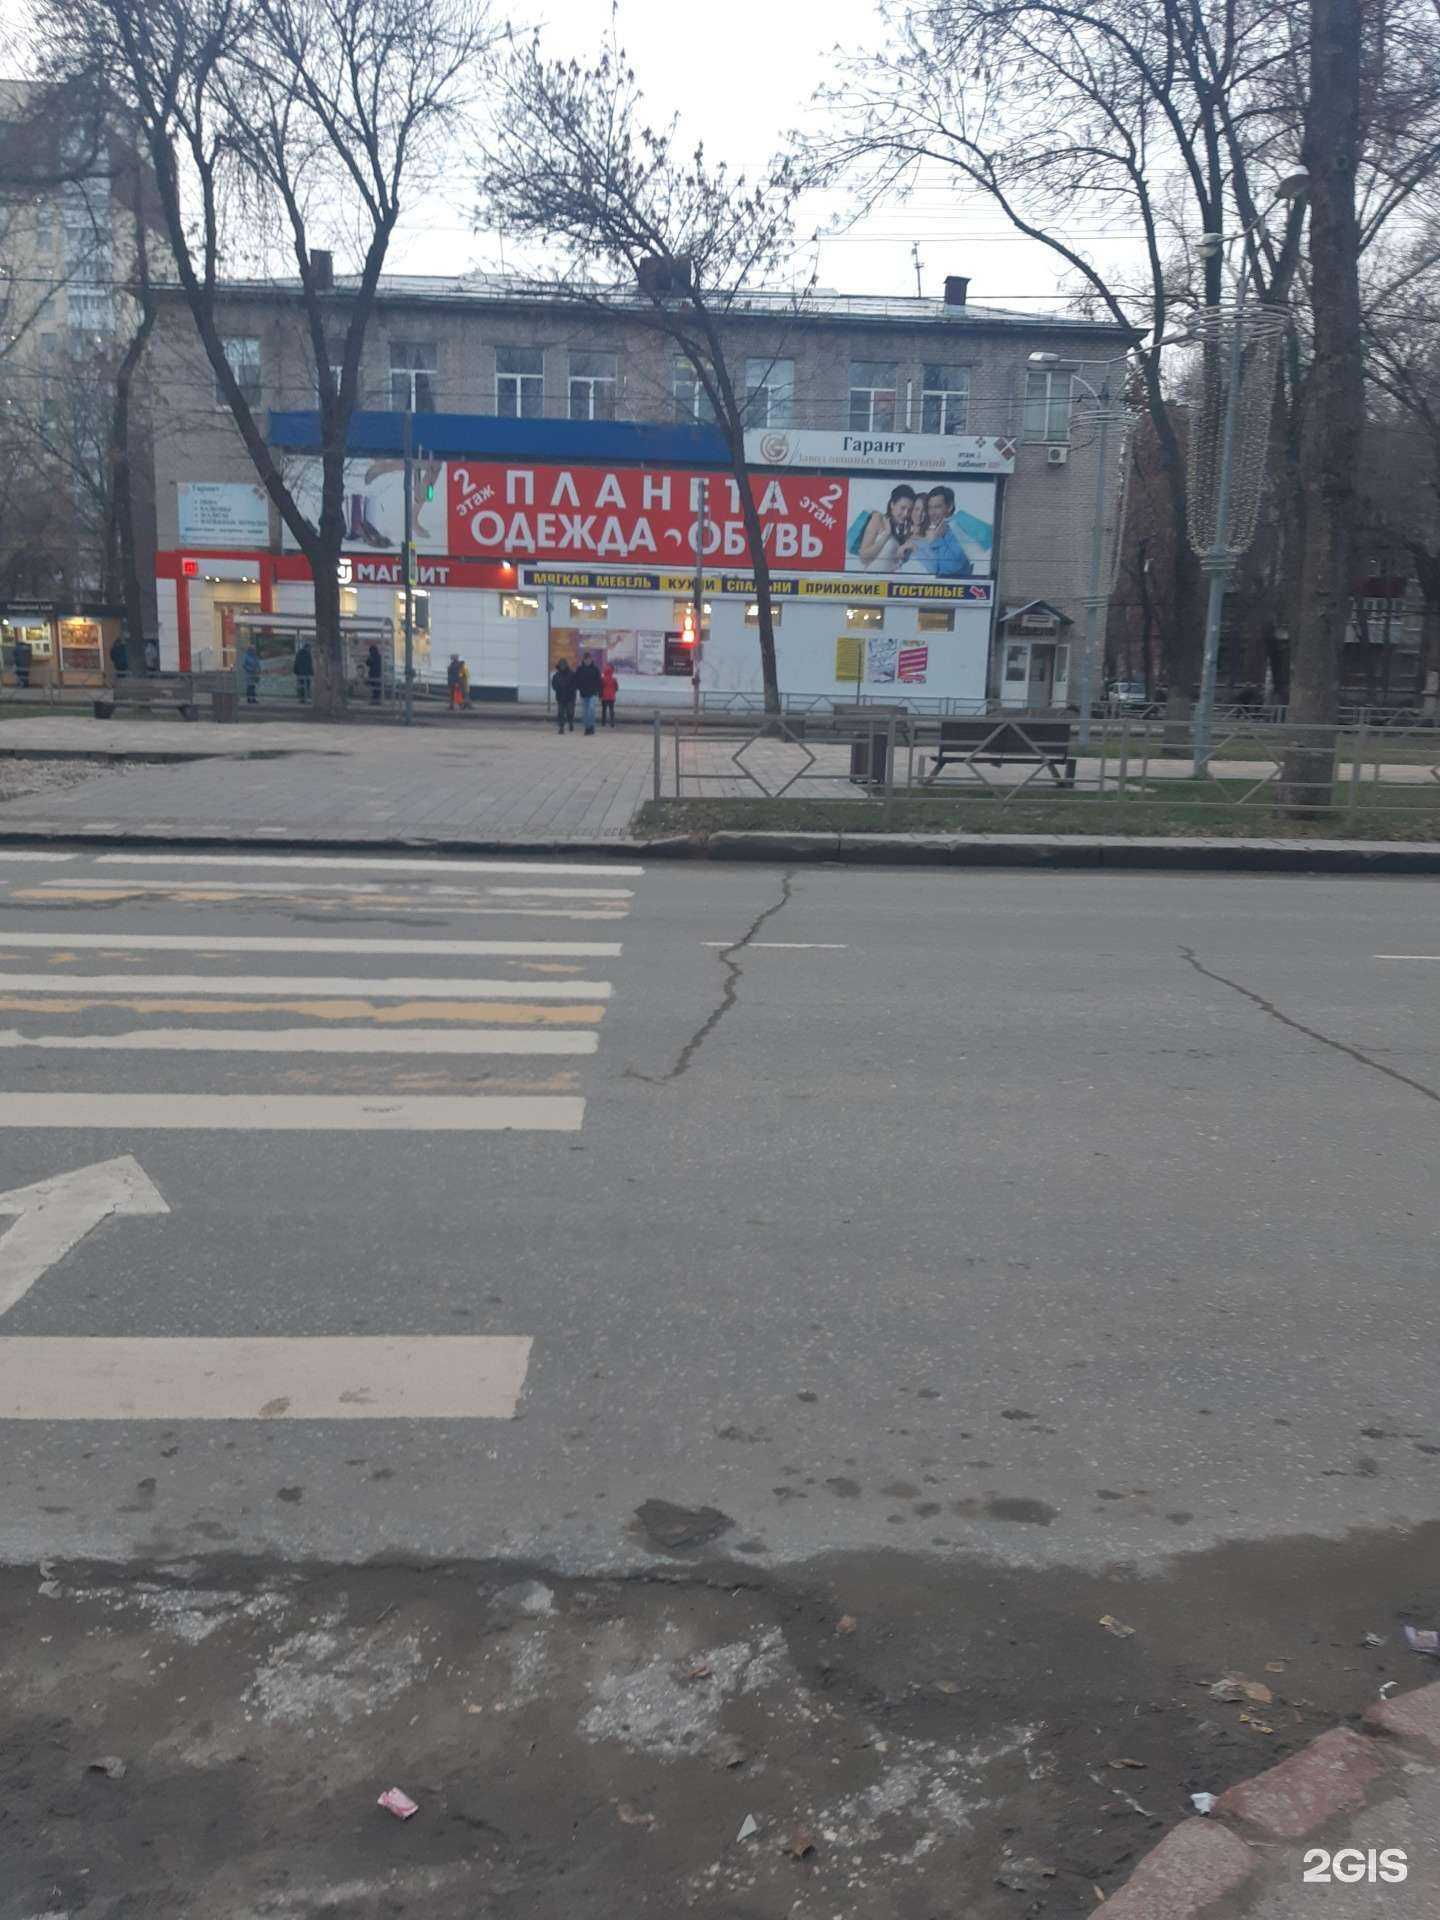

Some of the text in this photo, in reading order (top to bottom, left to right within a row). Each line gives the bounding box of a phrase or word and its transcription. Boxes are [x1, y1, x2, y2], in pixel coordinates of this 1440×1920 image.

[842, 436, 906, 455] Гарант
[453, 468, 477, 496] 2
[506, 469, 789, 516] ПЛАНЕТА
[819, 483, 843, 509] 2
[456, 484, 496, 517] этаж
[800, 496, 838, 530] этаж
[471, 510, 658, 558] ОДЕЖДА
[357, 563, 450, 584] МАГИТ
[596, 575, 652, 588] МЕБЕЛЬ
[668, 578, 715, 591] КУХИ
[727, 579, 792, 593] СПАНИ
[806, 582, 881, 596] ПРИХОЖИЕ
[892, 584, 965, 598] ГОСТИНЫЕ
